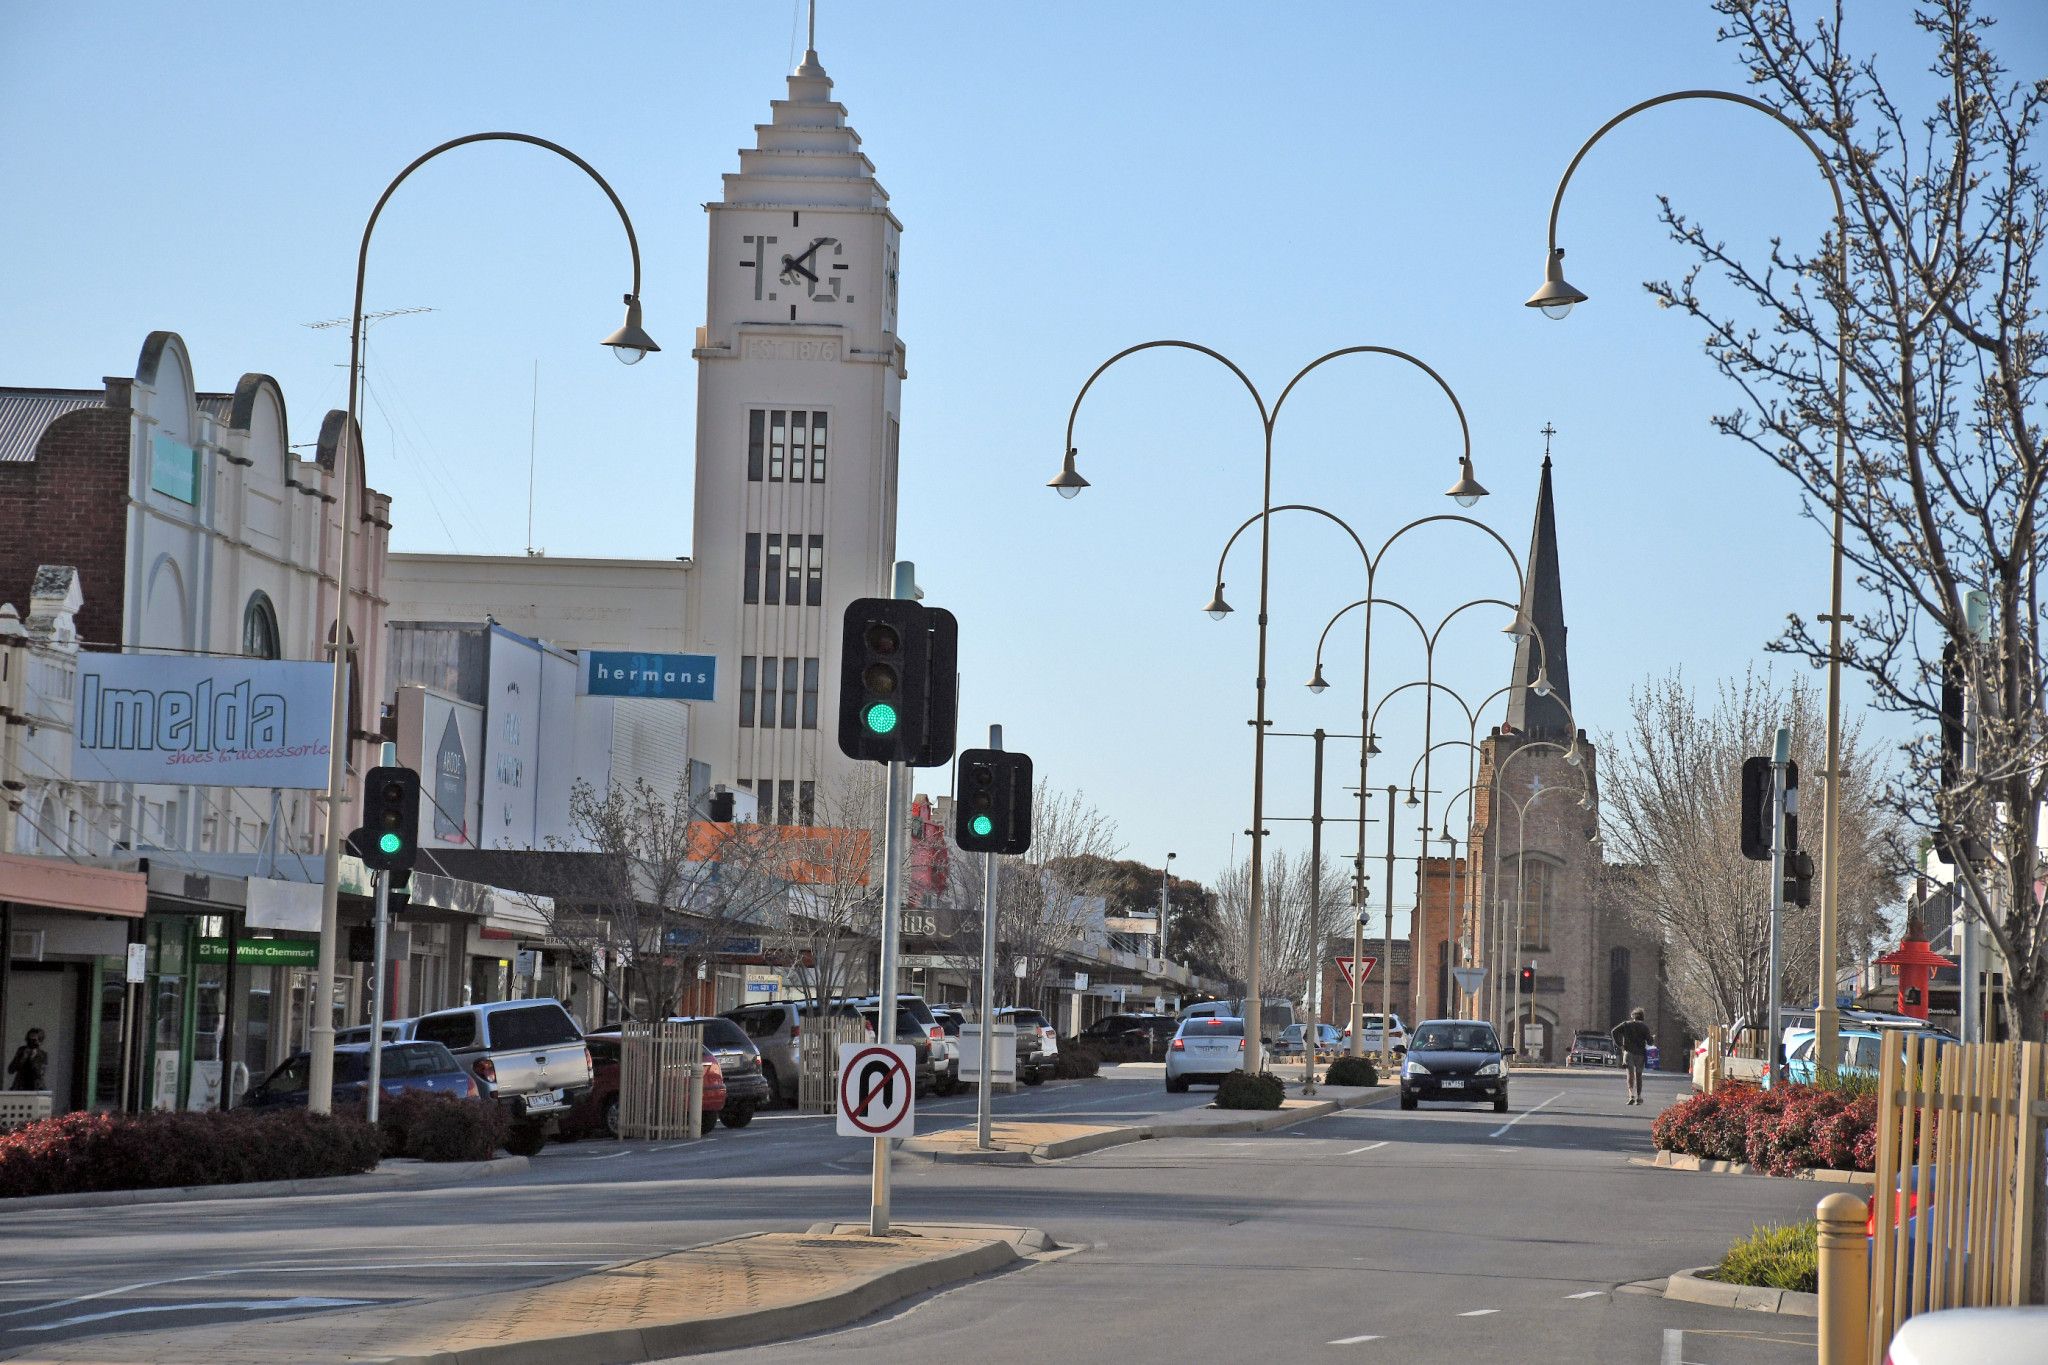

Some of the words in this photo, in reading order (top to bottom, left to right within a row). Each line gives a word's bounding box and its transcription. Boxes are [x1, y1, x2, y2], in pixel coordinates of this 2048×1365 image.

[597, 663, 706, 684] hermans
[80, 673, 286, 752] Imelda
[166, 749, 214, 766] shoes
[234, 738, 332, 761] accessorie
[265, 947, 315, 957] Chemmart
